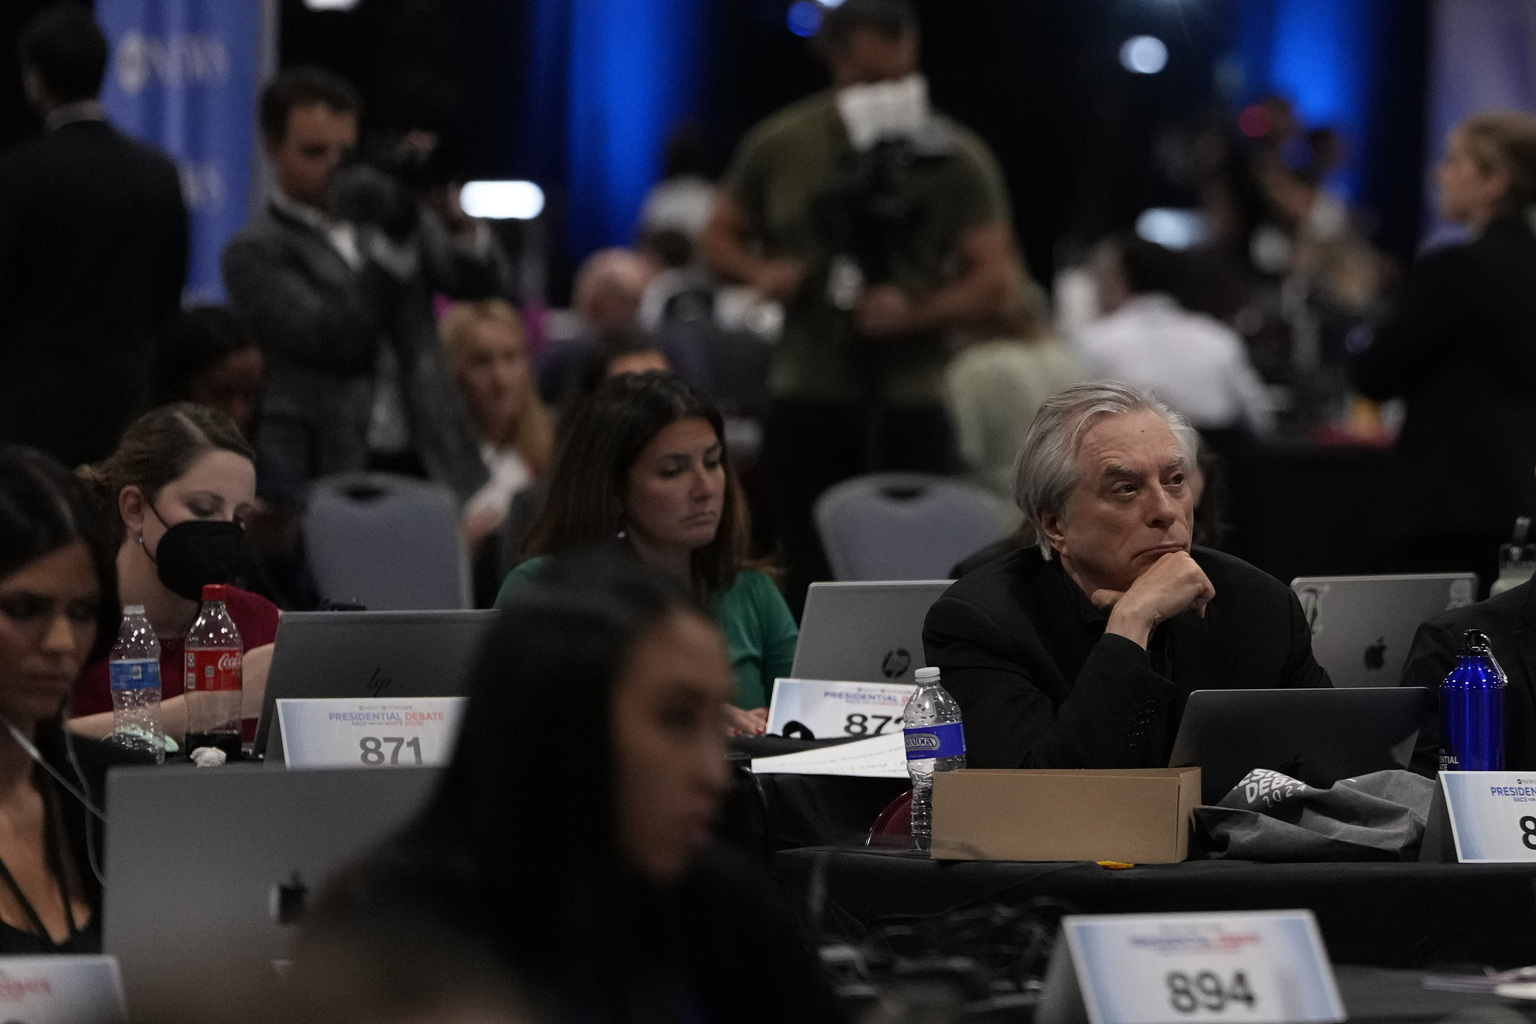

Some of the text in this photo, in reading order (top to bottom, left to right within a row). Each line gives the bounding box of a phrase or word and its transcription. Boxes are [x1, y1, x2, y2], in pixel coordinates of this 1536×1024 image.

[328, 711, 445, 721] PRESIDENTIAL DEBATE
[359, 736, 423, 767] 871
[1166, 969, 1256, 1014] 894
